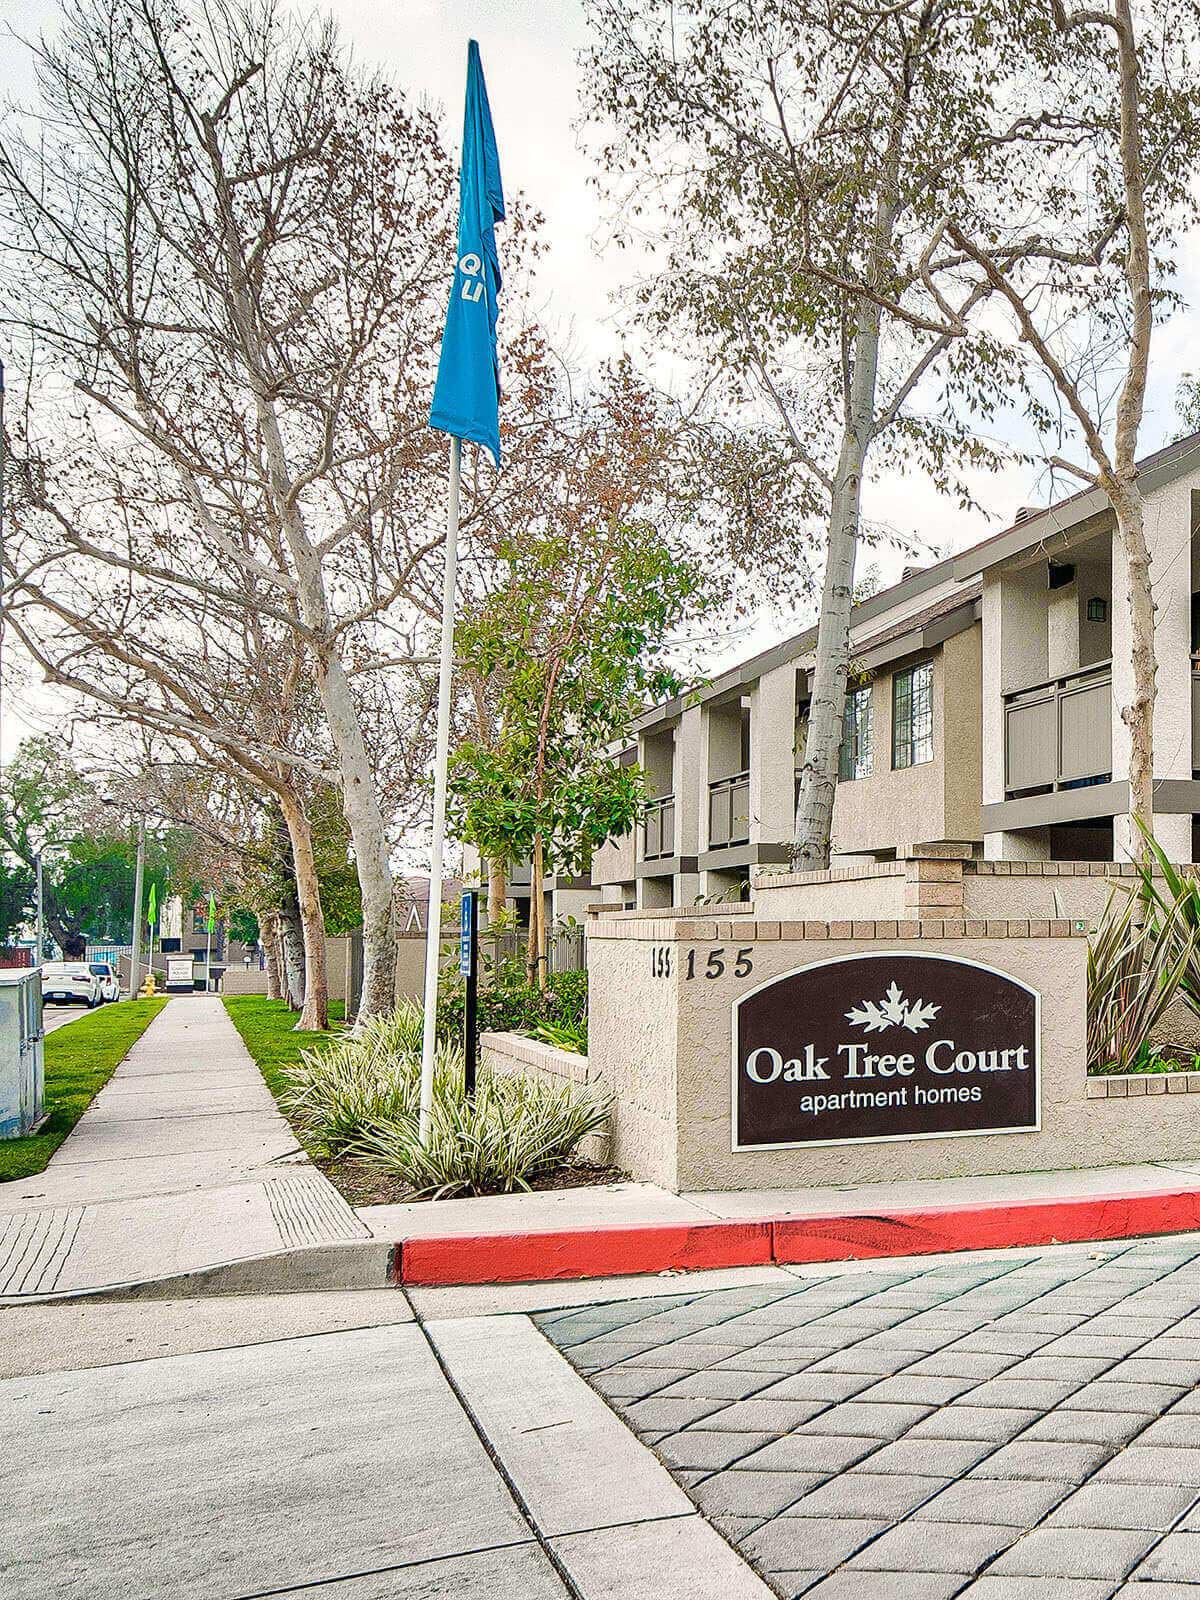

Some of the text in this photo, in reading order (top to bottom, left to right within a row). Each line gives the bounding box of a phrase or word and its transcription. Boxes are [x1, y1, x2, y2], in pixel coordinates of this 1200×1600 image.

[459, 253, 485, 277] Q
[652, 947, 671, 978] 155
[686, 947, 754, 980] 155
[746, 1040, 1030, 1083] Oak Tree Court
[800, 1085, 982, 1116] apartment homes
